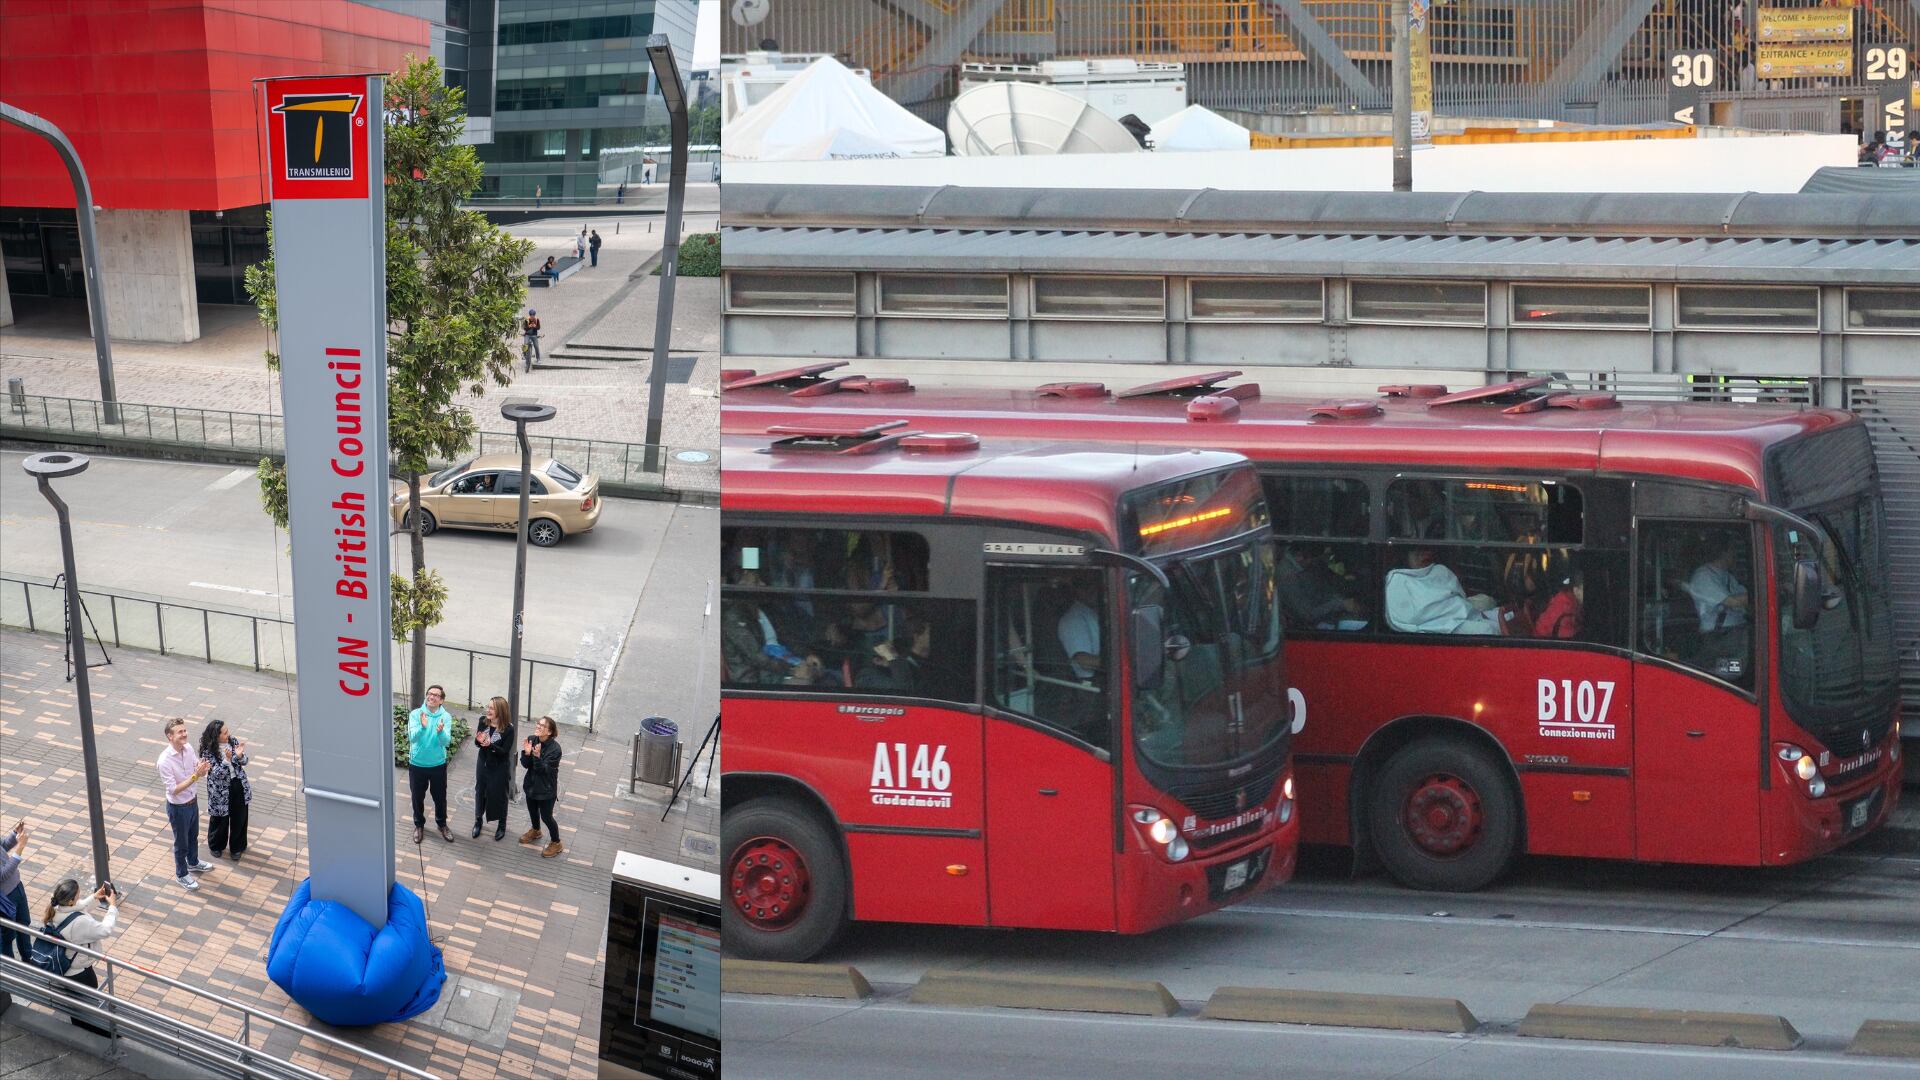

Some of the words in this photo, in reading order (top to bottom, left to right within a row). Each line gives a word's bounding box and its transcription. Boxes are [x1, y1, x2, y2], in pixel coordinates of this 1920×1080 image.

[1762, 14, 1800, 23] WELCOME
[1671, 53, 1714, 87] 30
[1760, 49, 1808, 59] ENTRANCE
[1817, 48, 1849, 58] Entrada
[1866, 47, 1907, 80] 29
[288, 167, 350, 177] TRANSMILENIO
[325, 347, 365, 478] Council
[332, 493, 368, 600] British
[1038, 545, 1085, 554] VIALE
[337, 636, 369, 697] CAN
[1537, 678, 1616, 723] B107
[1539, 726, 1615, 740] Connexionmóvil
[870, 742, 951, 791] A146
[871, 794, 951, 808] Ciudadmóvil
